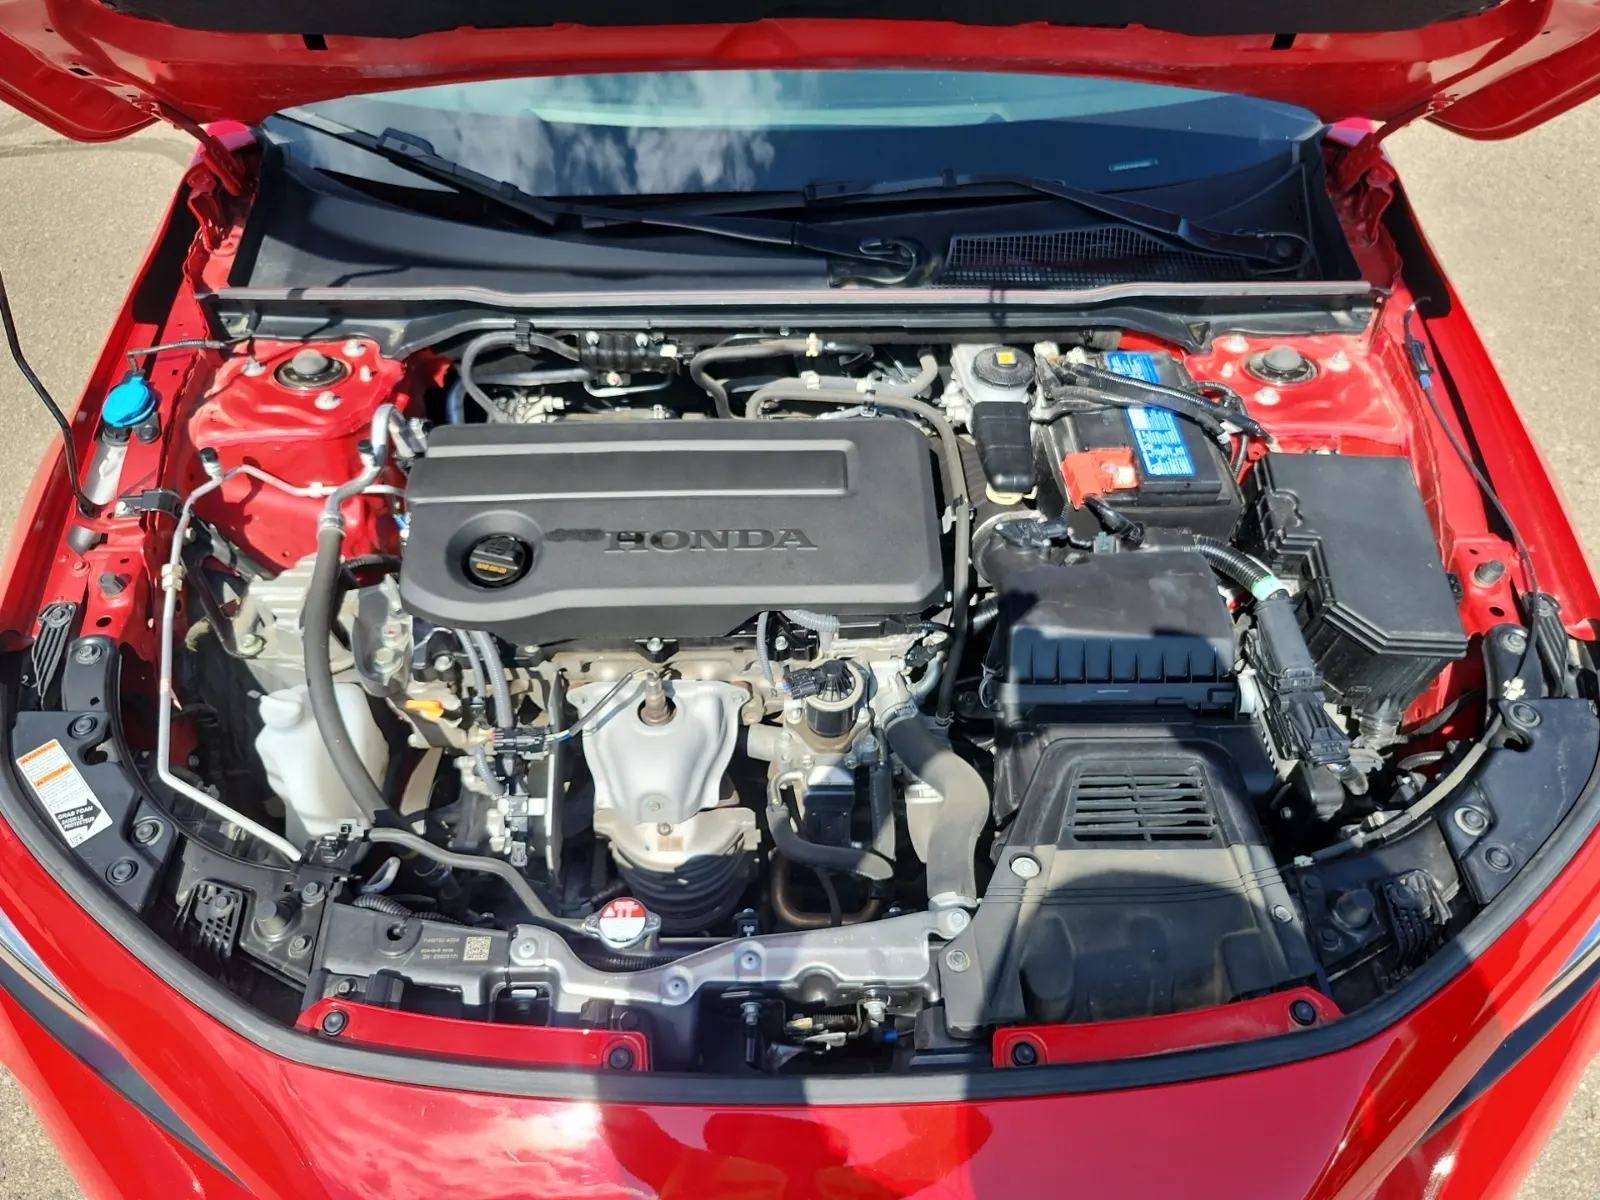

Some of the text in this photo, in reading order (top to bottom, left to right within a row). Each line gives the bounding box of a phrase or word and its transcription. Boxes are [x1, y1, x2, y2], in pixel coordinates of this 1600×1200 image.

[604, 529, 818, 553] HONDA
[57, 805, 94, 820] GRAB FOAM
